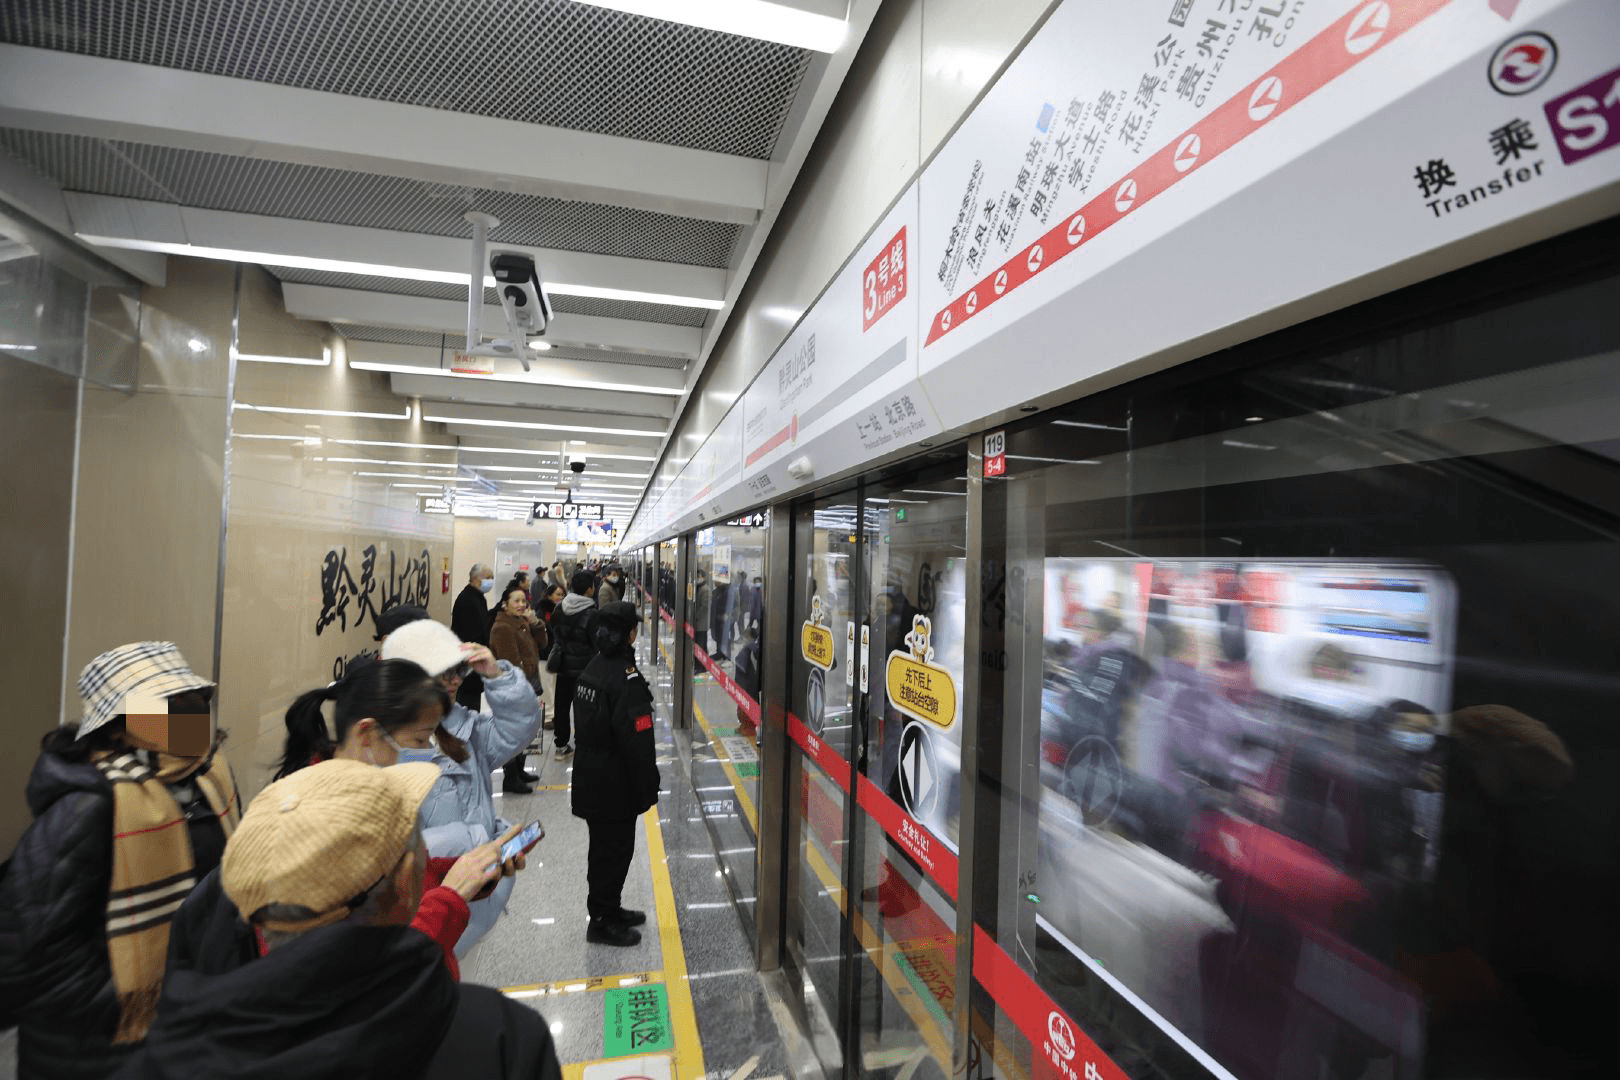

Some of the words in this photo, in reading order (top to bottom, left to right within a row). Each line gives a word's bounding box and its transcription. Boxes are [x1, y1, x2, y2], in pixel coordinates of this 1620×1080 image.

[1118, 0, 1195, 146] 花溪公园
[1132, 102, 1161, 153] Huaxi
[1159, 49, 1186, 93] Park
[1194, 19, 1243, 108] Guizhou
[1030, 97, 1084, 217] 明珠大道
[1040, 163, 1068, 225] Mingzhu
[1066, 102, 1093, 161] Avenue
[1068, 90, 1115, 188] 学士路
[1080, 139, 1107, 194] Xueshi
[1104, 90, 1127, 135] Road
[1414, 117, 1539, 199] 换乘
[996, 137, 1041, 245] 花溪南站
[1426, 159, 1544, 217] Transfer
[879, 285, 897, 311] Line
[898, 274, 904, 292] 3
[986, 433, 1003, 454] 119
[987, 461, 1002, 474] 5-4
[900, 683, 939, 715] 注意站台空隙
[905, 667, 931, 691] 先下后上
[628, 987, 661, 1049] 排队区
